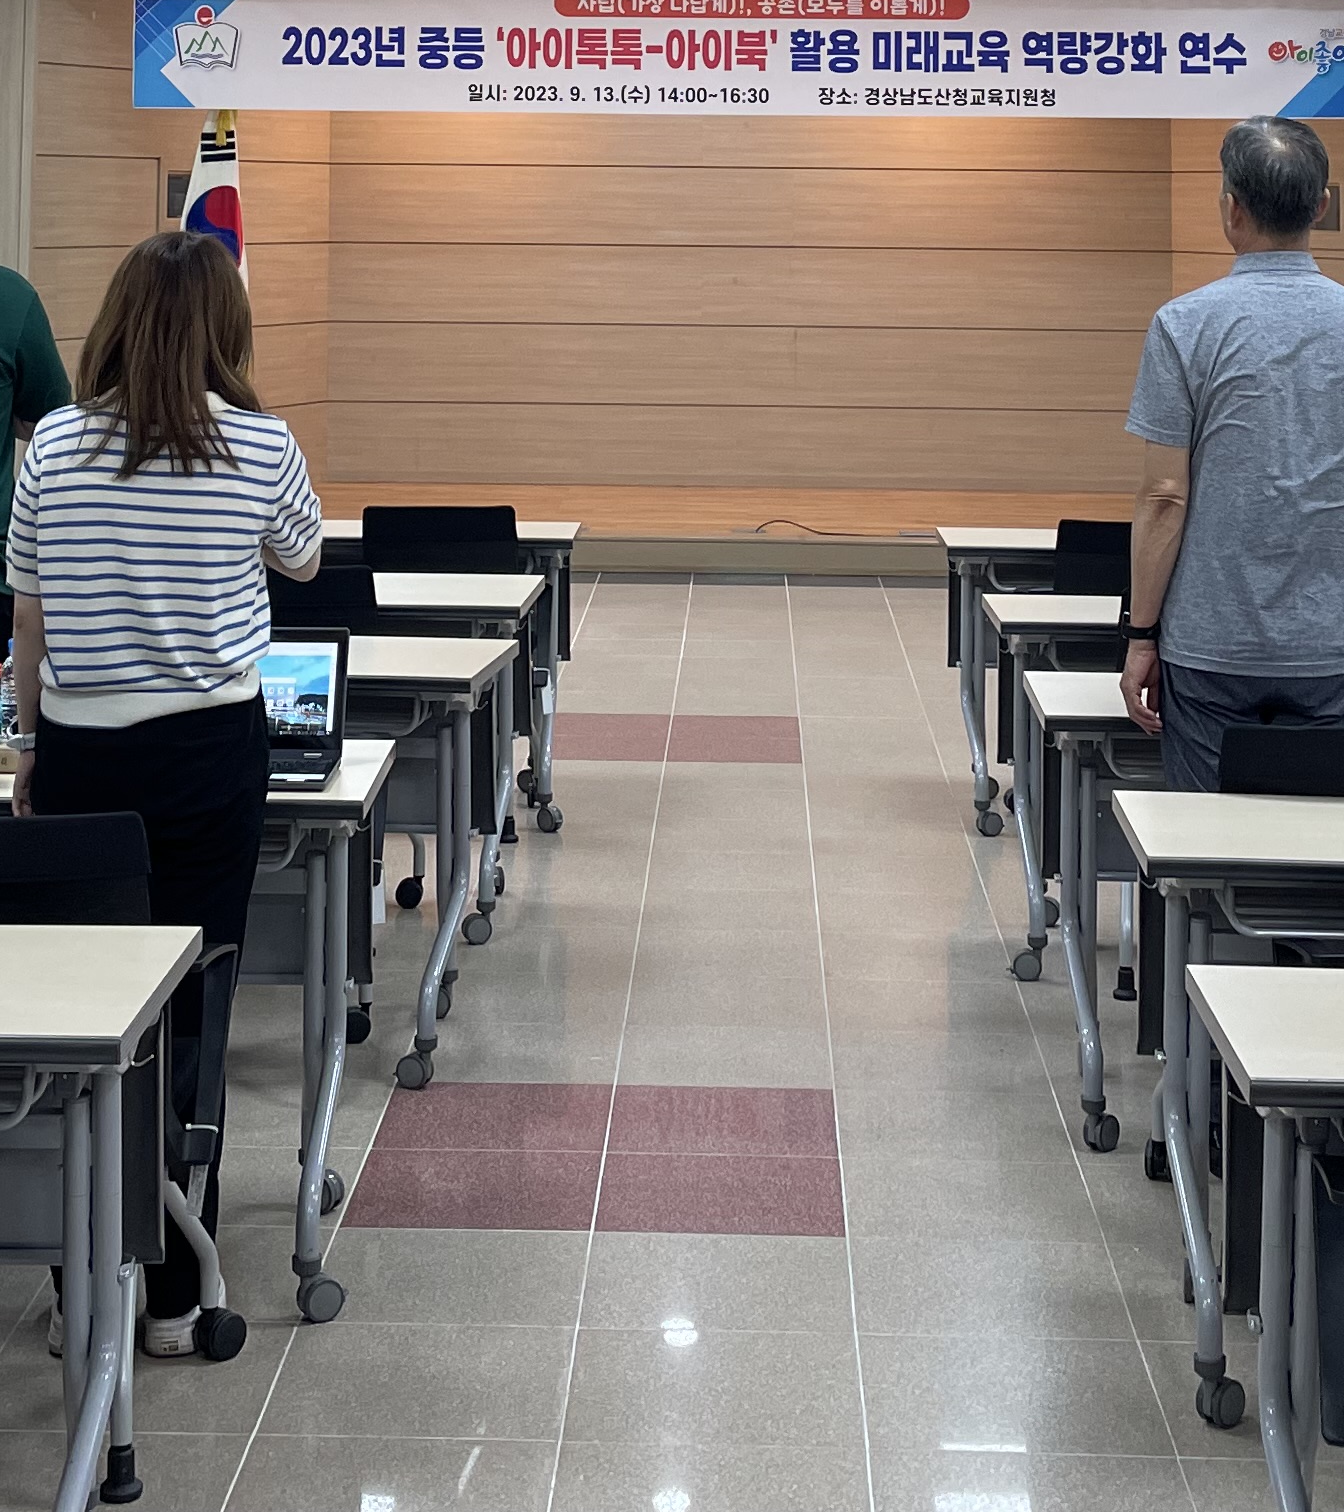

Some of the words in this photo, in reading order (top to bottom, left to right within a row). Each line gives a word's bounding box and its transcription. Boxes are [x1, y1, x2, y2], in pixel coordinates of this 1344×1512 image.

[281, 25, 406, 68] 2023년
[417, 26, 485, 70] 중등
[789, 28, 861, 74] 활용
[872, 29, 1011, 74] 미래교육
[1022, 30, 1168, 76] 역량강화
[1178, 31, 1248, 75] 연수
[467, 83, 508, 103] 일시:
[513, 85, 564, 102] 2023.
[569, 86, 586, 102] 9.
[593, 84, 651, 105] 13.(수)
[658, 86, 771, 105] 14:00~16:30
[818, 86, 858, 105] 장소:
[863, 87, 1057, 107] 경상남도산청교육지원청
